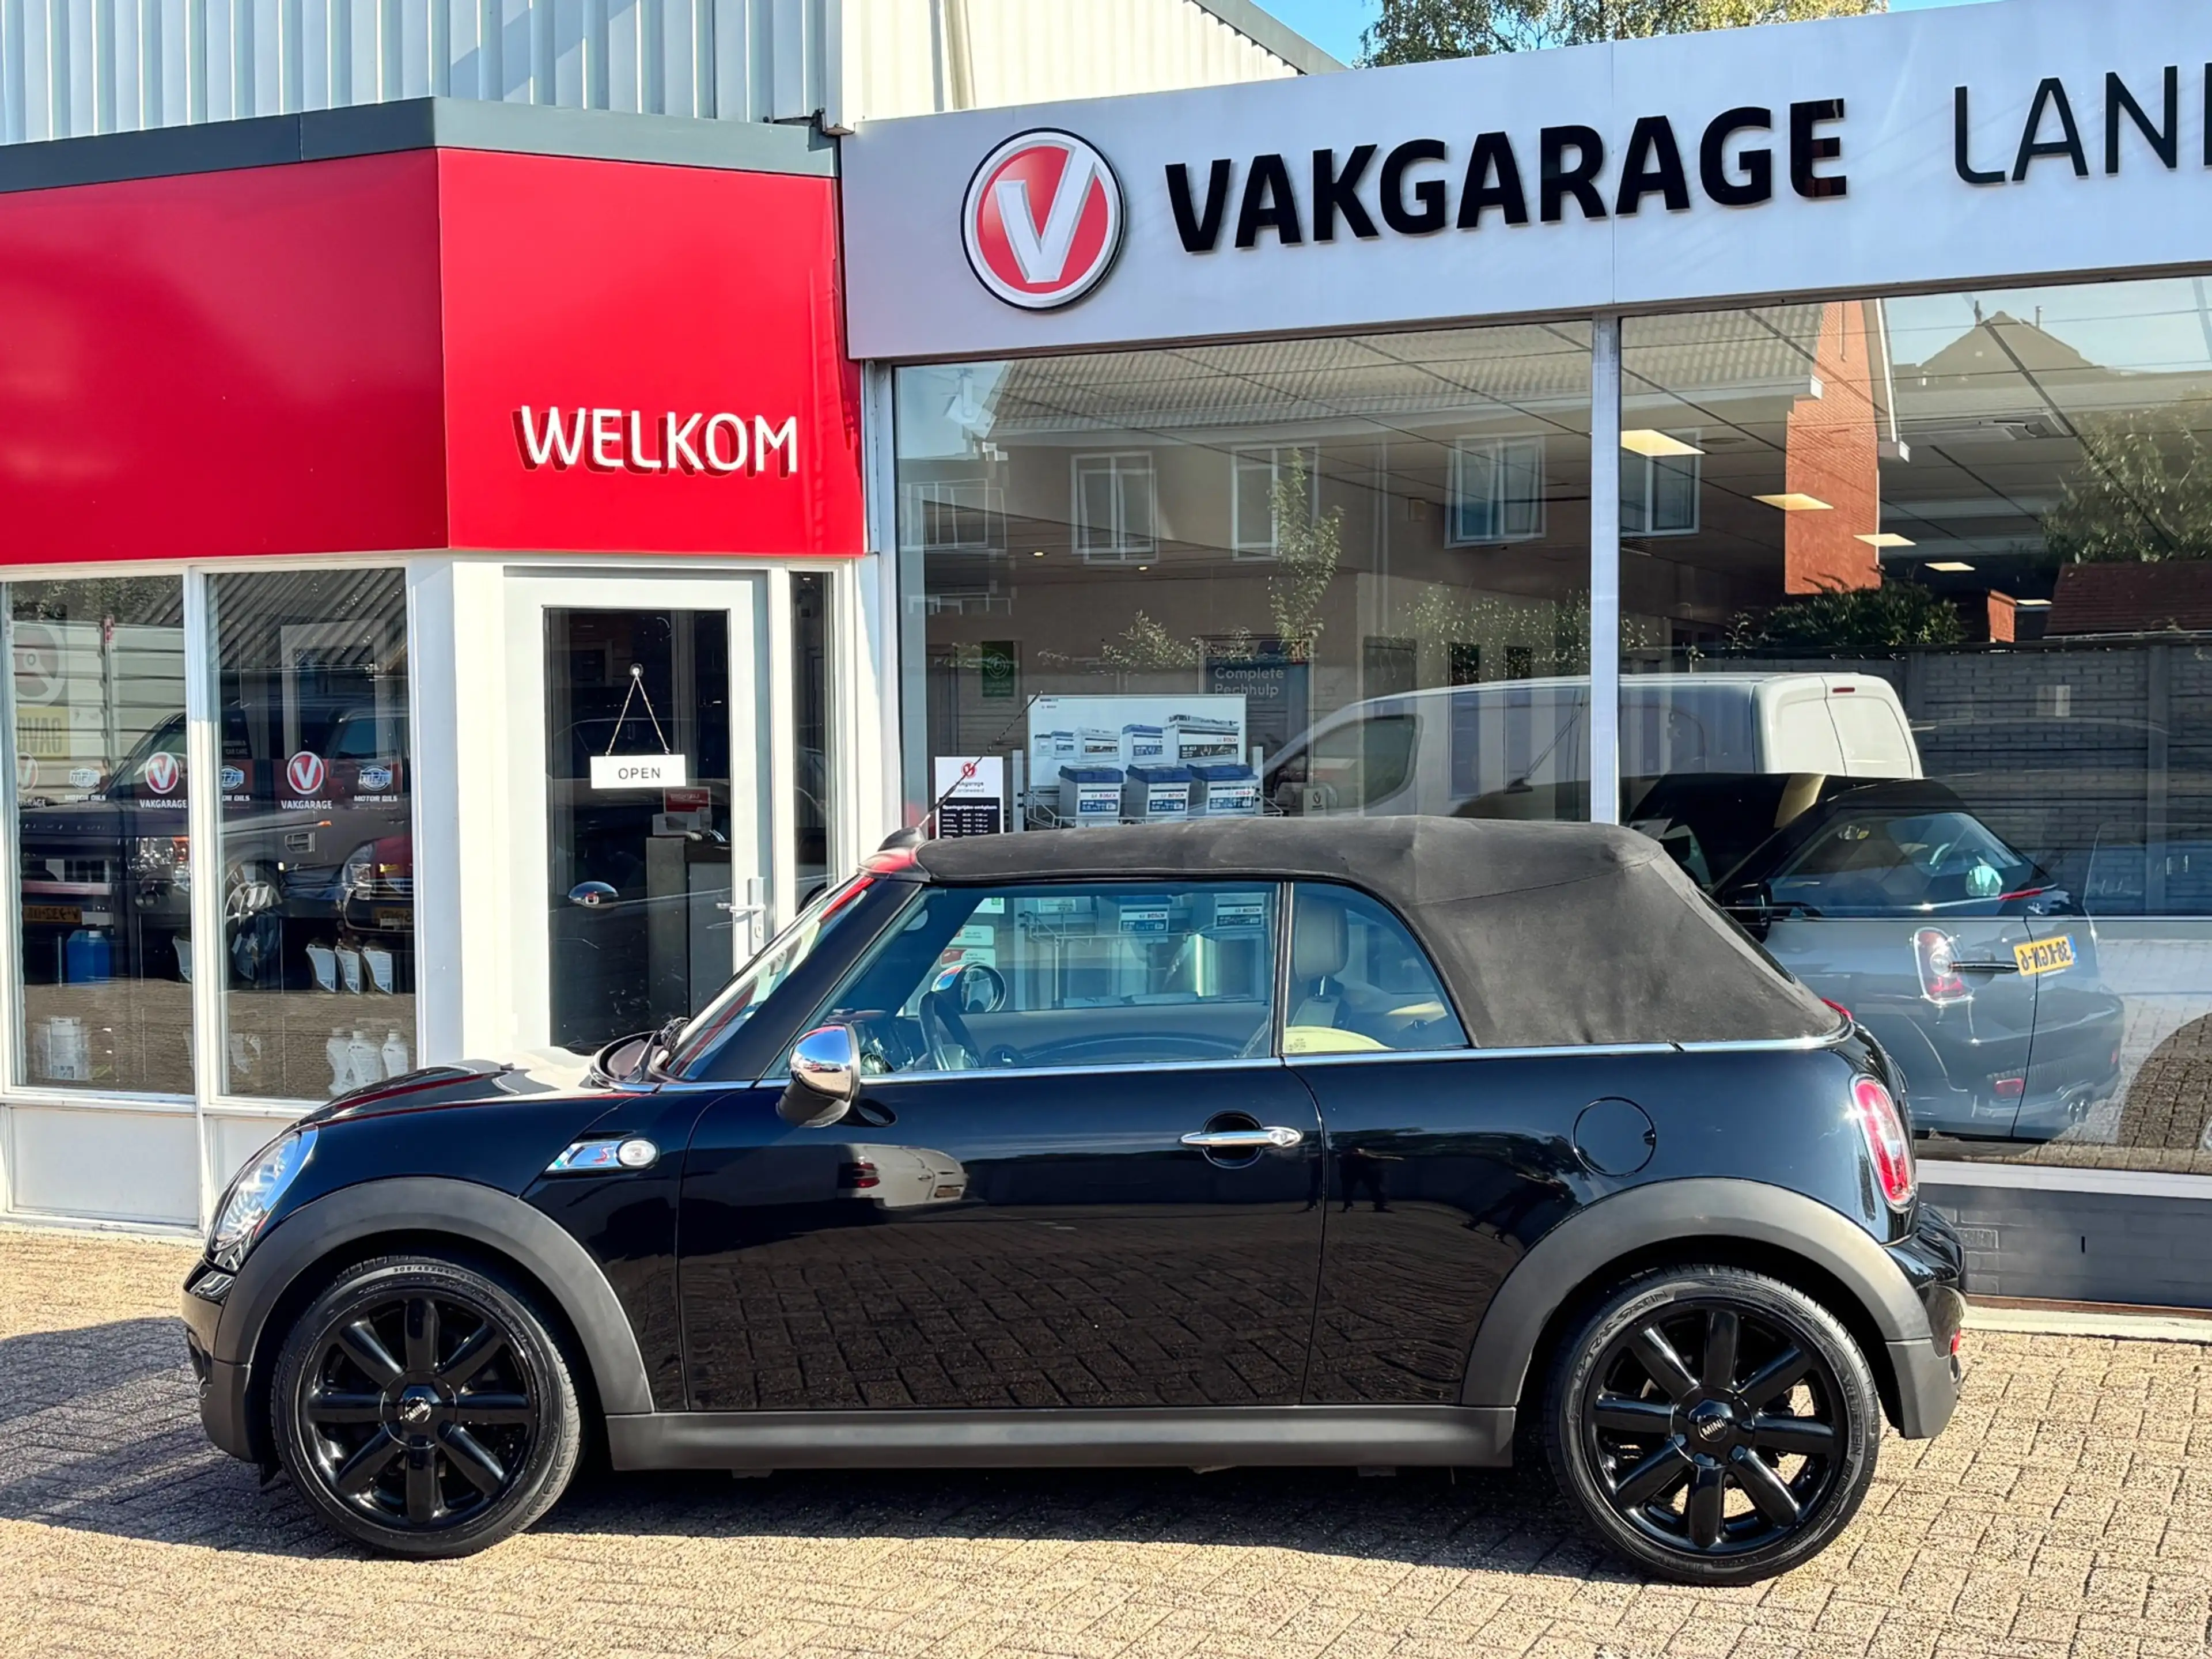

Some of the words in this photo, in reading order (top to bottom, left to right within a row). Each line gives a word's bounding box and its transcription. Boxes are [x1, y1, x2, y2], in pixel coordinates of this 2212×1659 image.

[1165, 98, 1847, 253] VAKGARAGE
[1955, 62, 2212, 185] LAN
[520, 404, 798, 474] WELKOM
[1215, 666, 1284, 681] Complete
[1215, 683, 1279, 698] Pechhulp
[618, 767, 661, 780] OPEN
[139, 799, 188, 809] VAKGARAGE
[281, 800, 333, 810] VAKGARAGE
[1700, 1419, 1725, 1436] MINI
